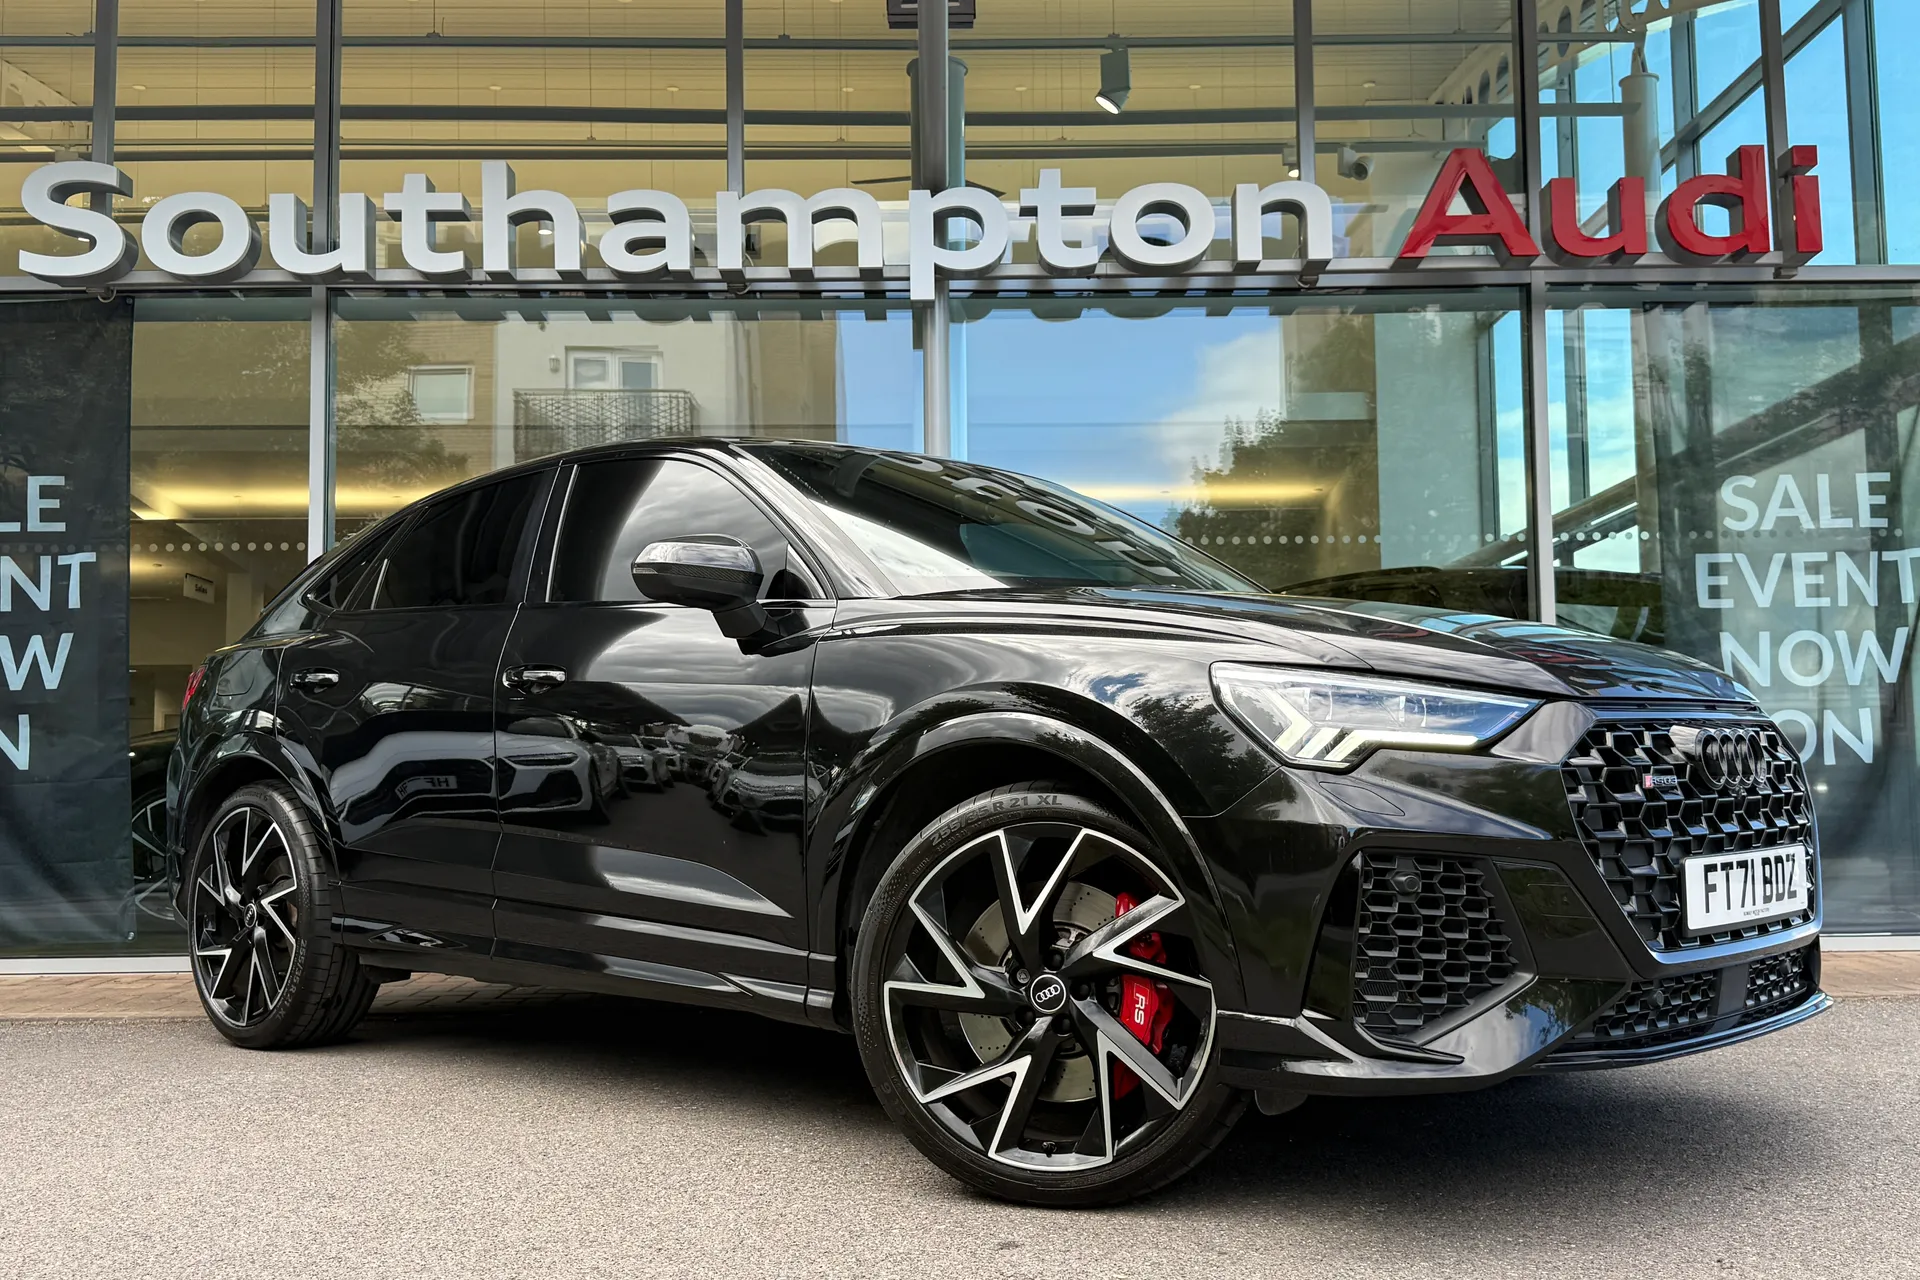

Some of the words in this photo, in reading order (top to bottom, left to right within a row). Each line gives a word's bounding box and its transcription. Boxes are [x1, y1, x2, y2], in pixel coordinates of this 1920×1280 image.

[18, 160, 1334, 302] Southampton
[1398, 144, 1823, 264] Audi
[1720, 471, 1891, 531] SALE
[1694, 547, 1920, 609] EVENT
[1719, 626, 1910, 688] NOW
[930, 805, 990, 846] 255/35
[992, 800, 1005, 813] R
[1009, 796, 1029, 808] 21
[1037, 794, 1063, 806] XL
[1703, 858, 1757, 914] FT71
[1761, 853, 1798, 905] BDZ
[1134, 992, 1146, 1026] RS
